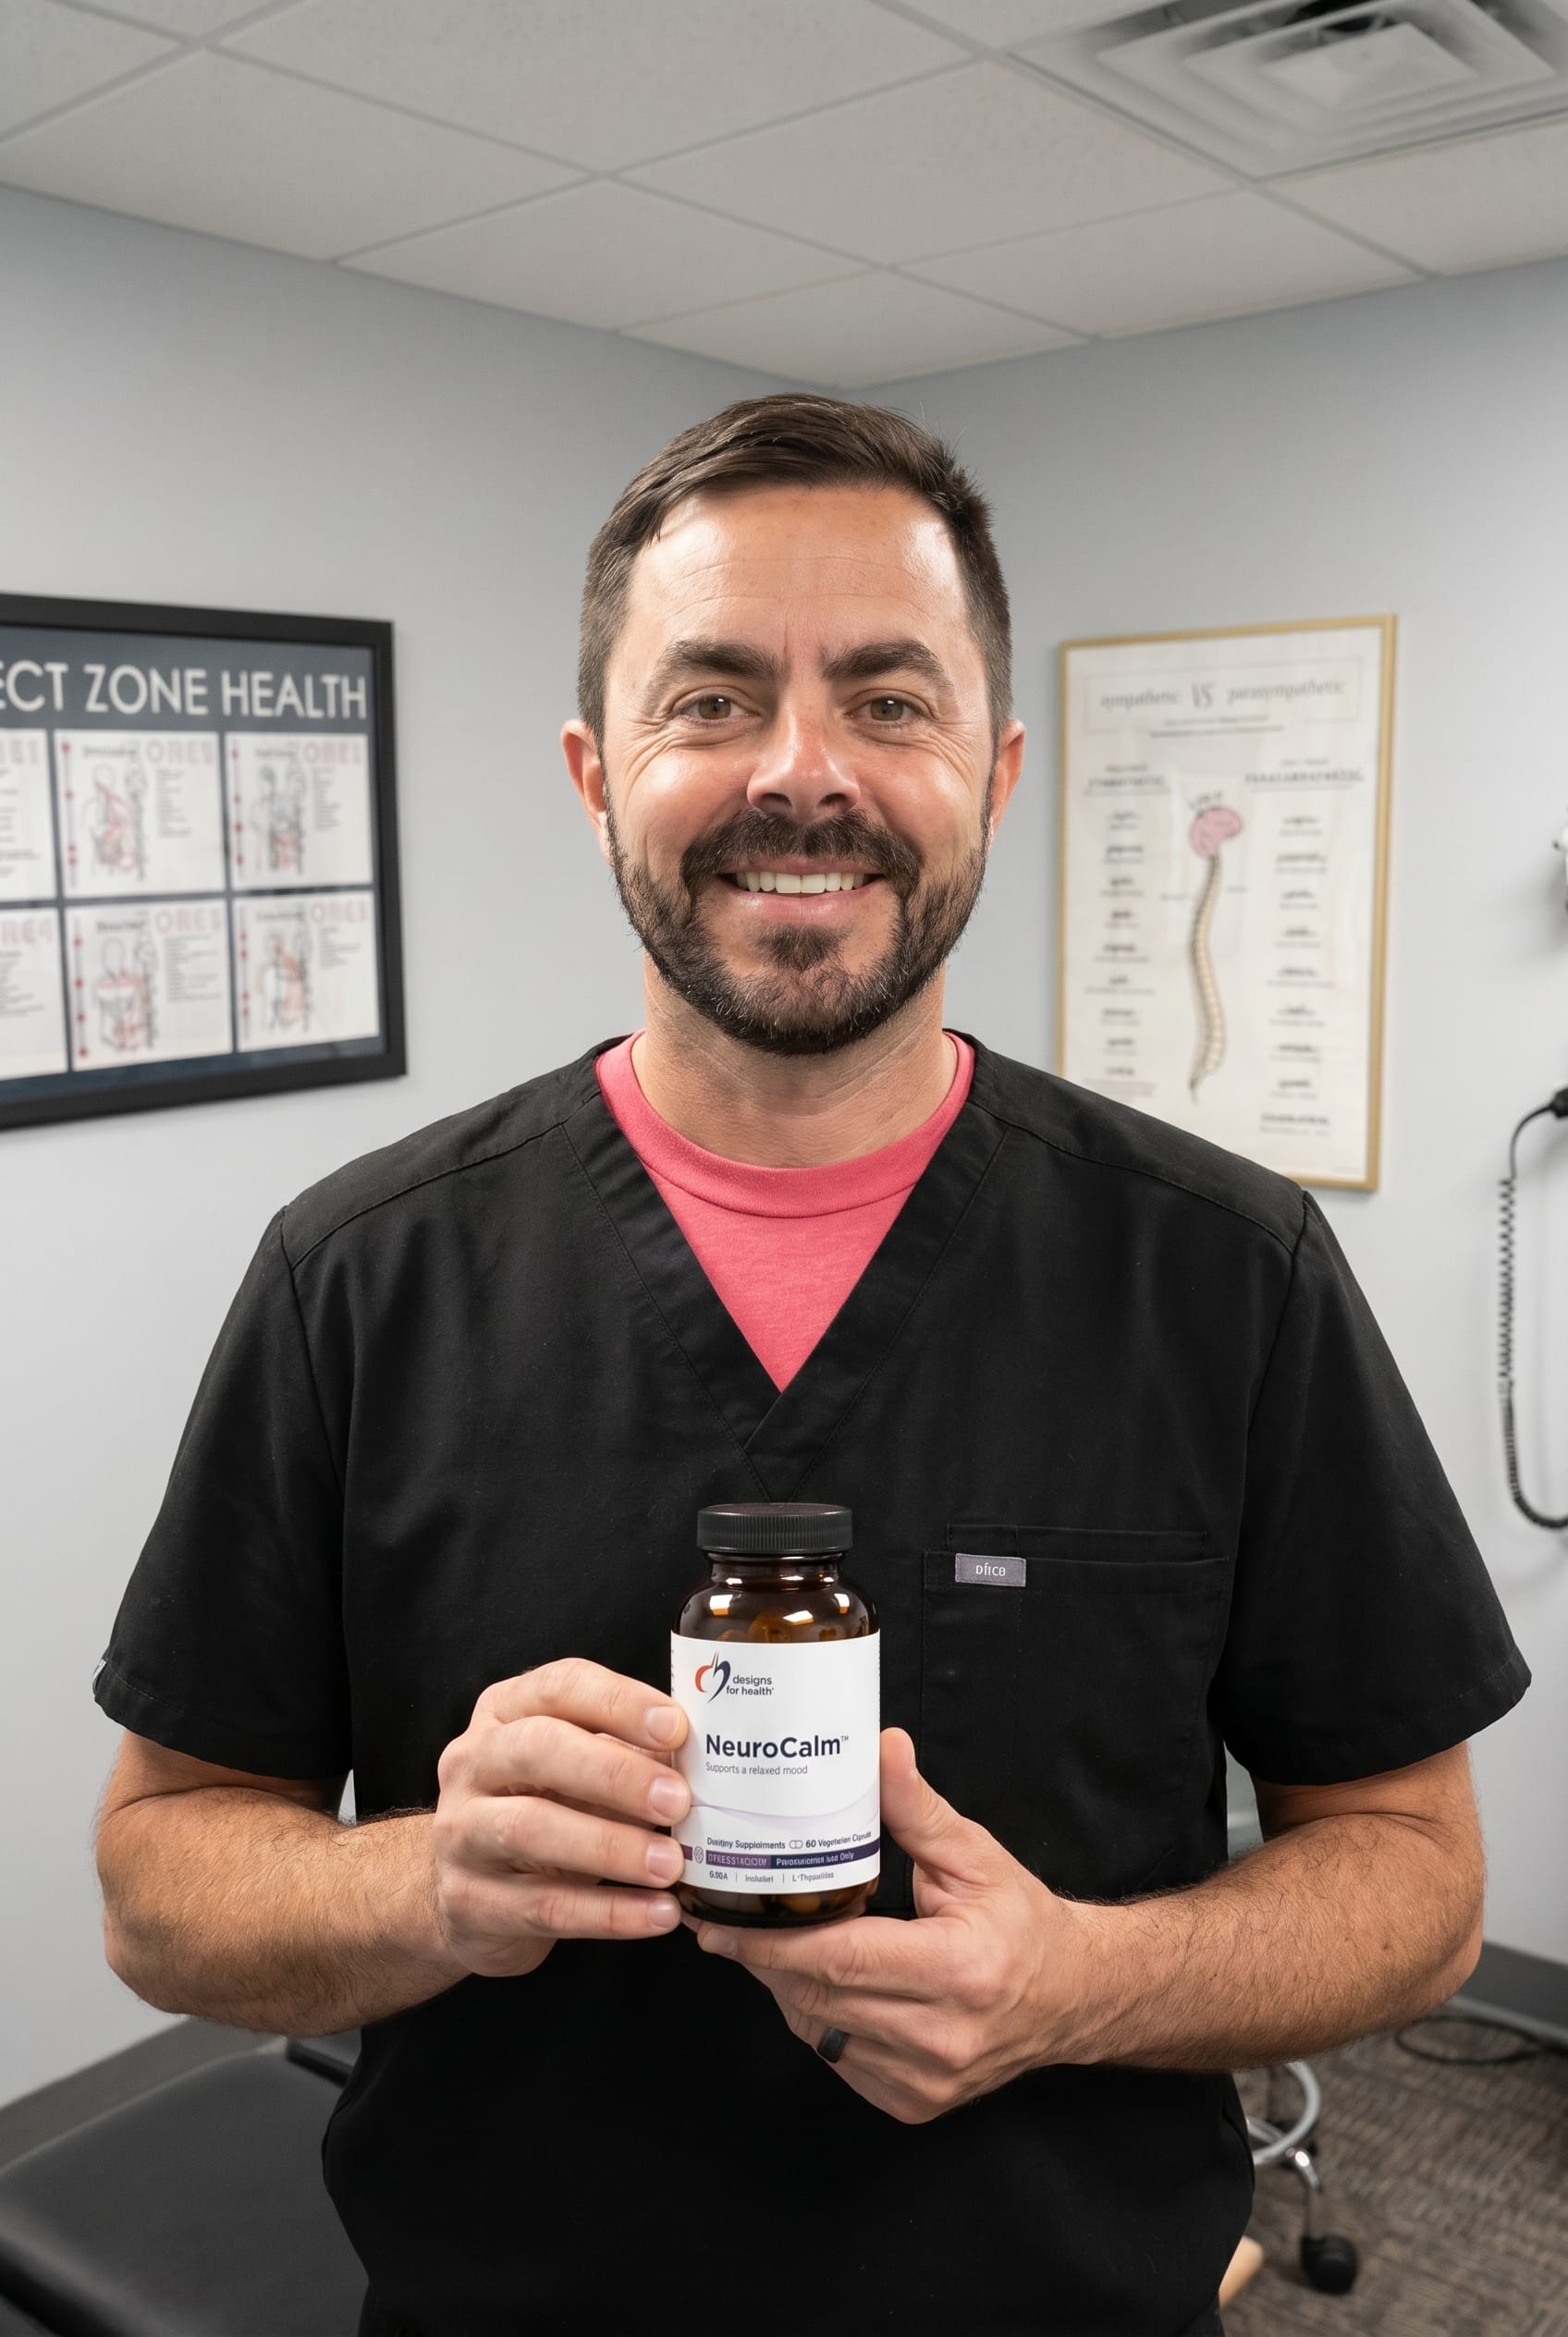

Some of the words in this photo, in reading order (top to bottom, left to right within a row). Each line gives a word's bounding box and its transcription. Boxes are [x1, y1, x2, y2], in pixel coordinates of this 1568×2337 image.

[83, 664, 209, 716] ZONE
[221, 670, 368, 719] HEALTH
[732, 1674, 773, 1687] designs
[726, 1685, 740, 1695] for
[705, 1761, 740, 1774] Supports
[741, 1767, 747, 1775] a
[749, 1765, 781, 1776] relaxed
[783, 1765, 809, 1775] mood
[805, 1840, 816, 1848] 60
